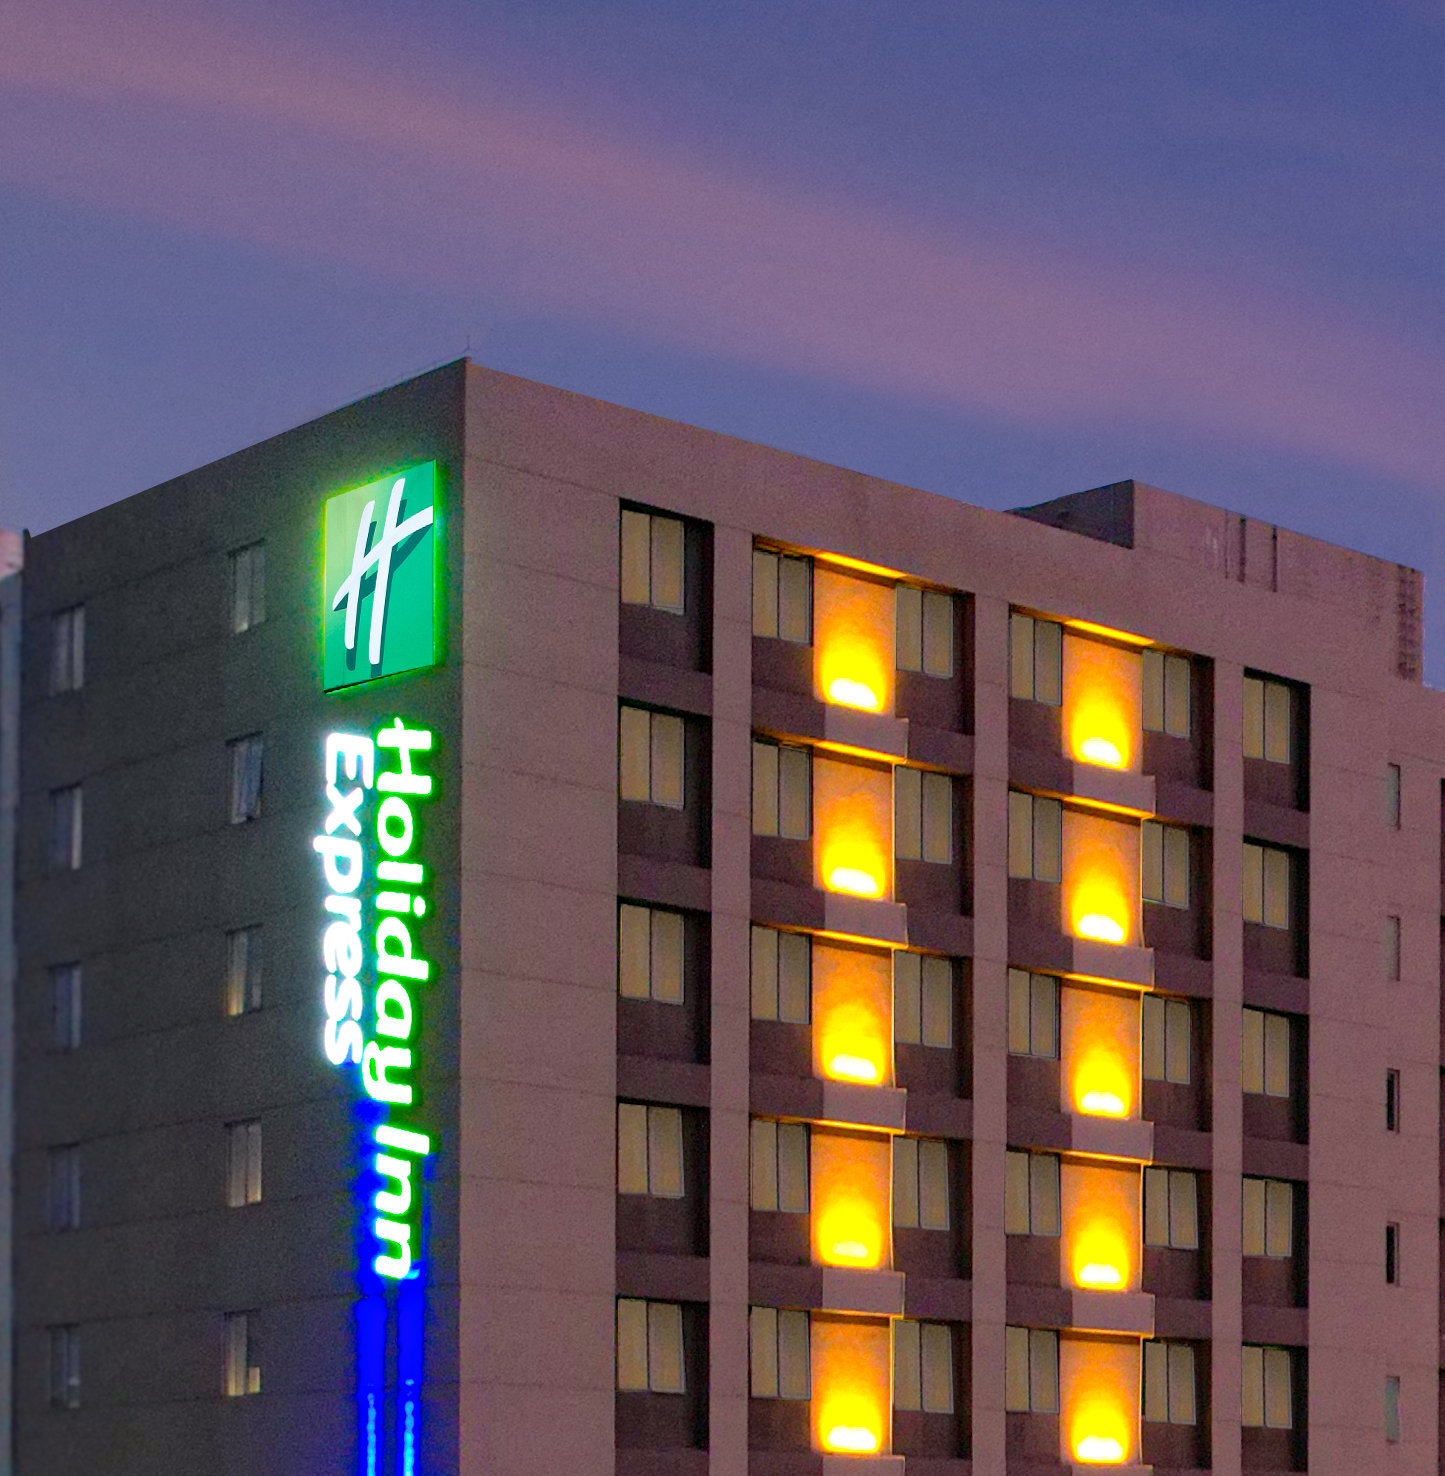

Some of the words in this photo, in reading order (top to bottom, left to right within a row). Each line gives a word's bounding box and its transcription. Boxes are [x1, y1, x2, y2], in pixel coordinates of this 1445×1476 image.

[313, 732, 374, 1067] Express
[362, 716, 432, 1105] Holiday
[375, 1124, 430, 1279] Inn
